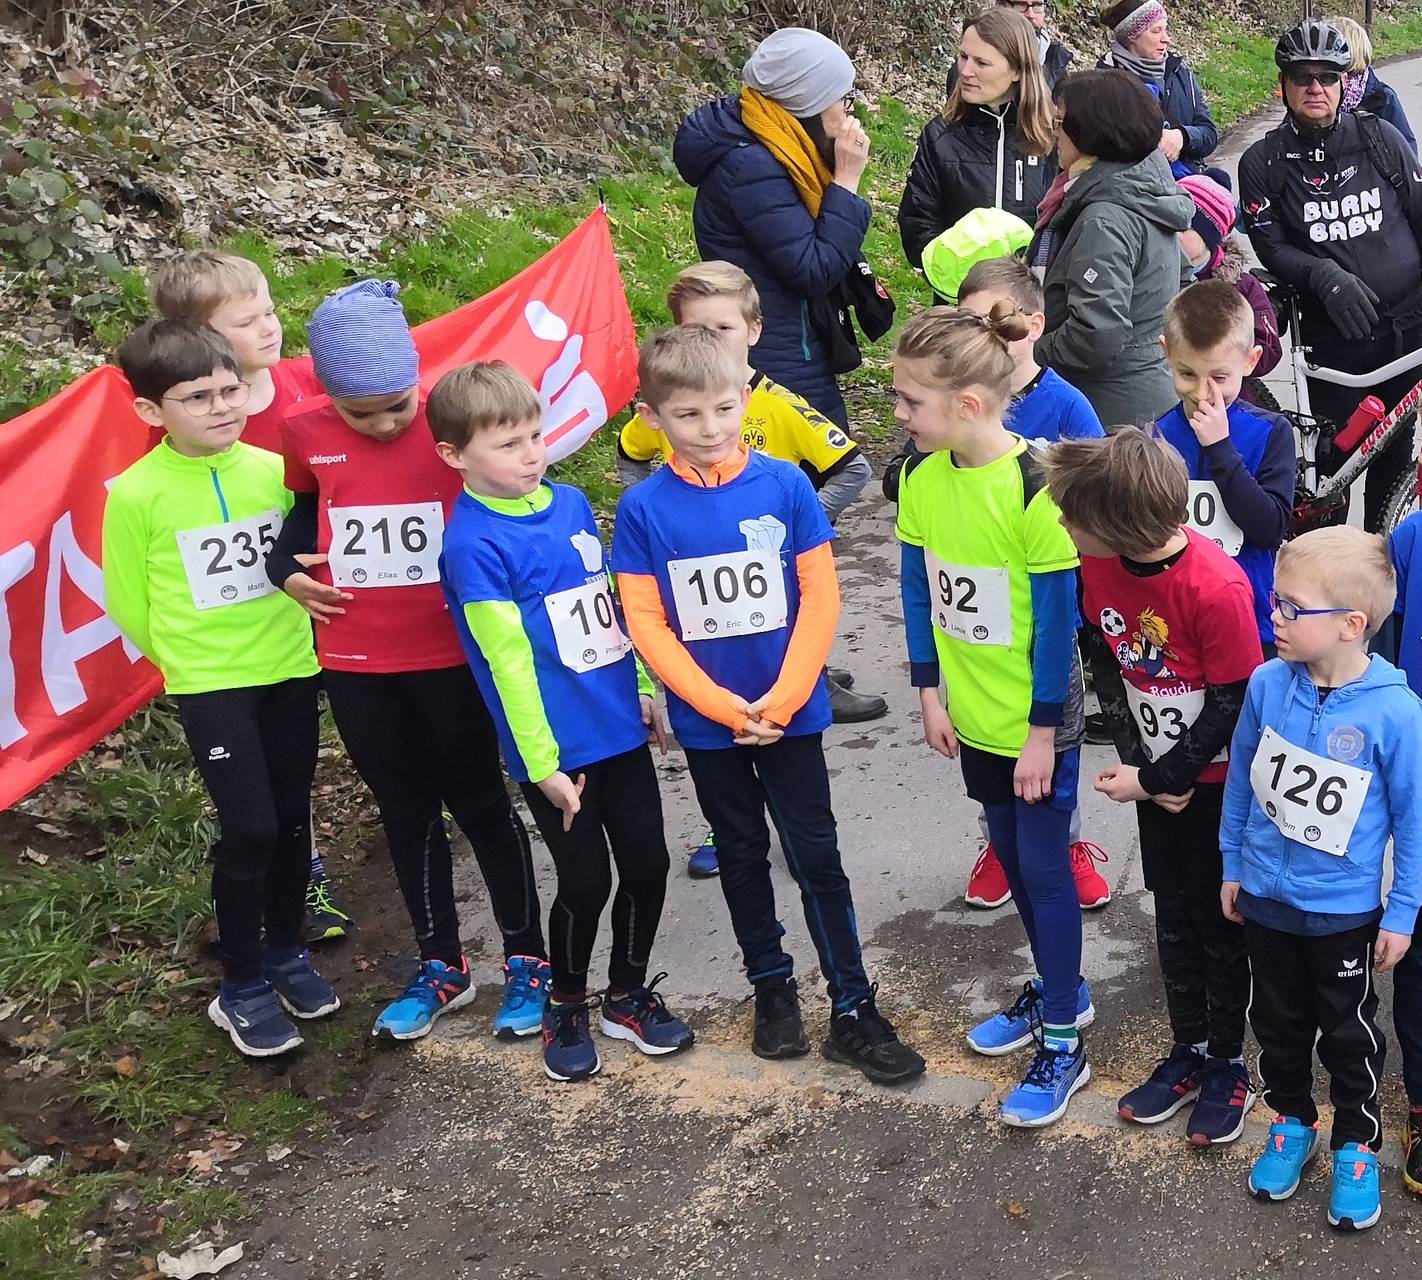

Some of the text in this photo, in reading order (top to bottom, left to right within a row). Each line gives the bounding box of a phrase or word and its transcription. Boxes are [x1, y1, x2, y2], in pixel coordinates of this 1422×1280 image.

[1303, 187, 1381, 223] BURN
[1309, 209, 1383, 243] BABY
[743, 429, 764, 446] BVB
[309, 453, 348, 465] uhlsport
[200, 522, 277, 576] 235
[343, 515, 428, 556] 216
[688, 561, 768, 607] 106
[938, 569, 978, 613] 92
[570, 591, 612, 636] 10
[726, 620, 742, 629] Eric
[1149, 681, 1192, 697] Raudi
[1139, 701, 1188, 741] 93
[1269, 752, 1348, 816] 126
[1337, 967, 1364, 978] erima
